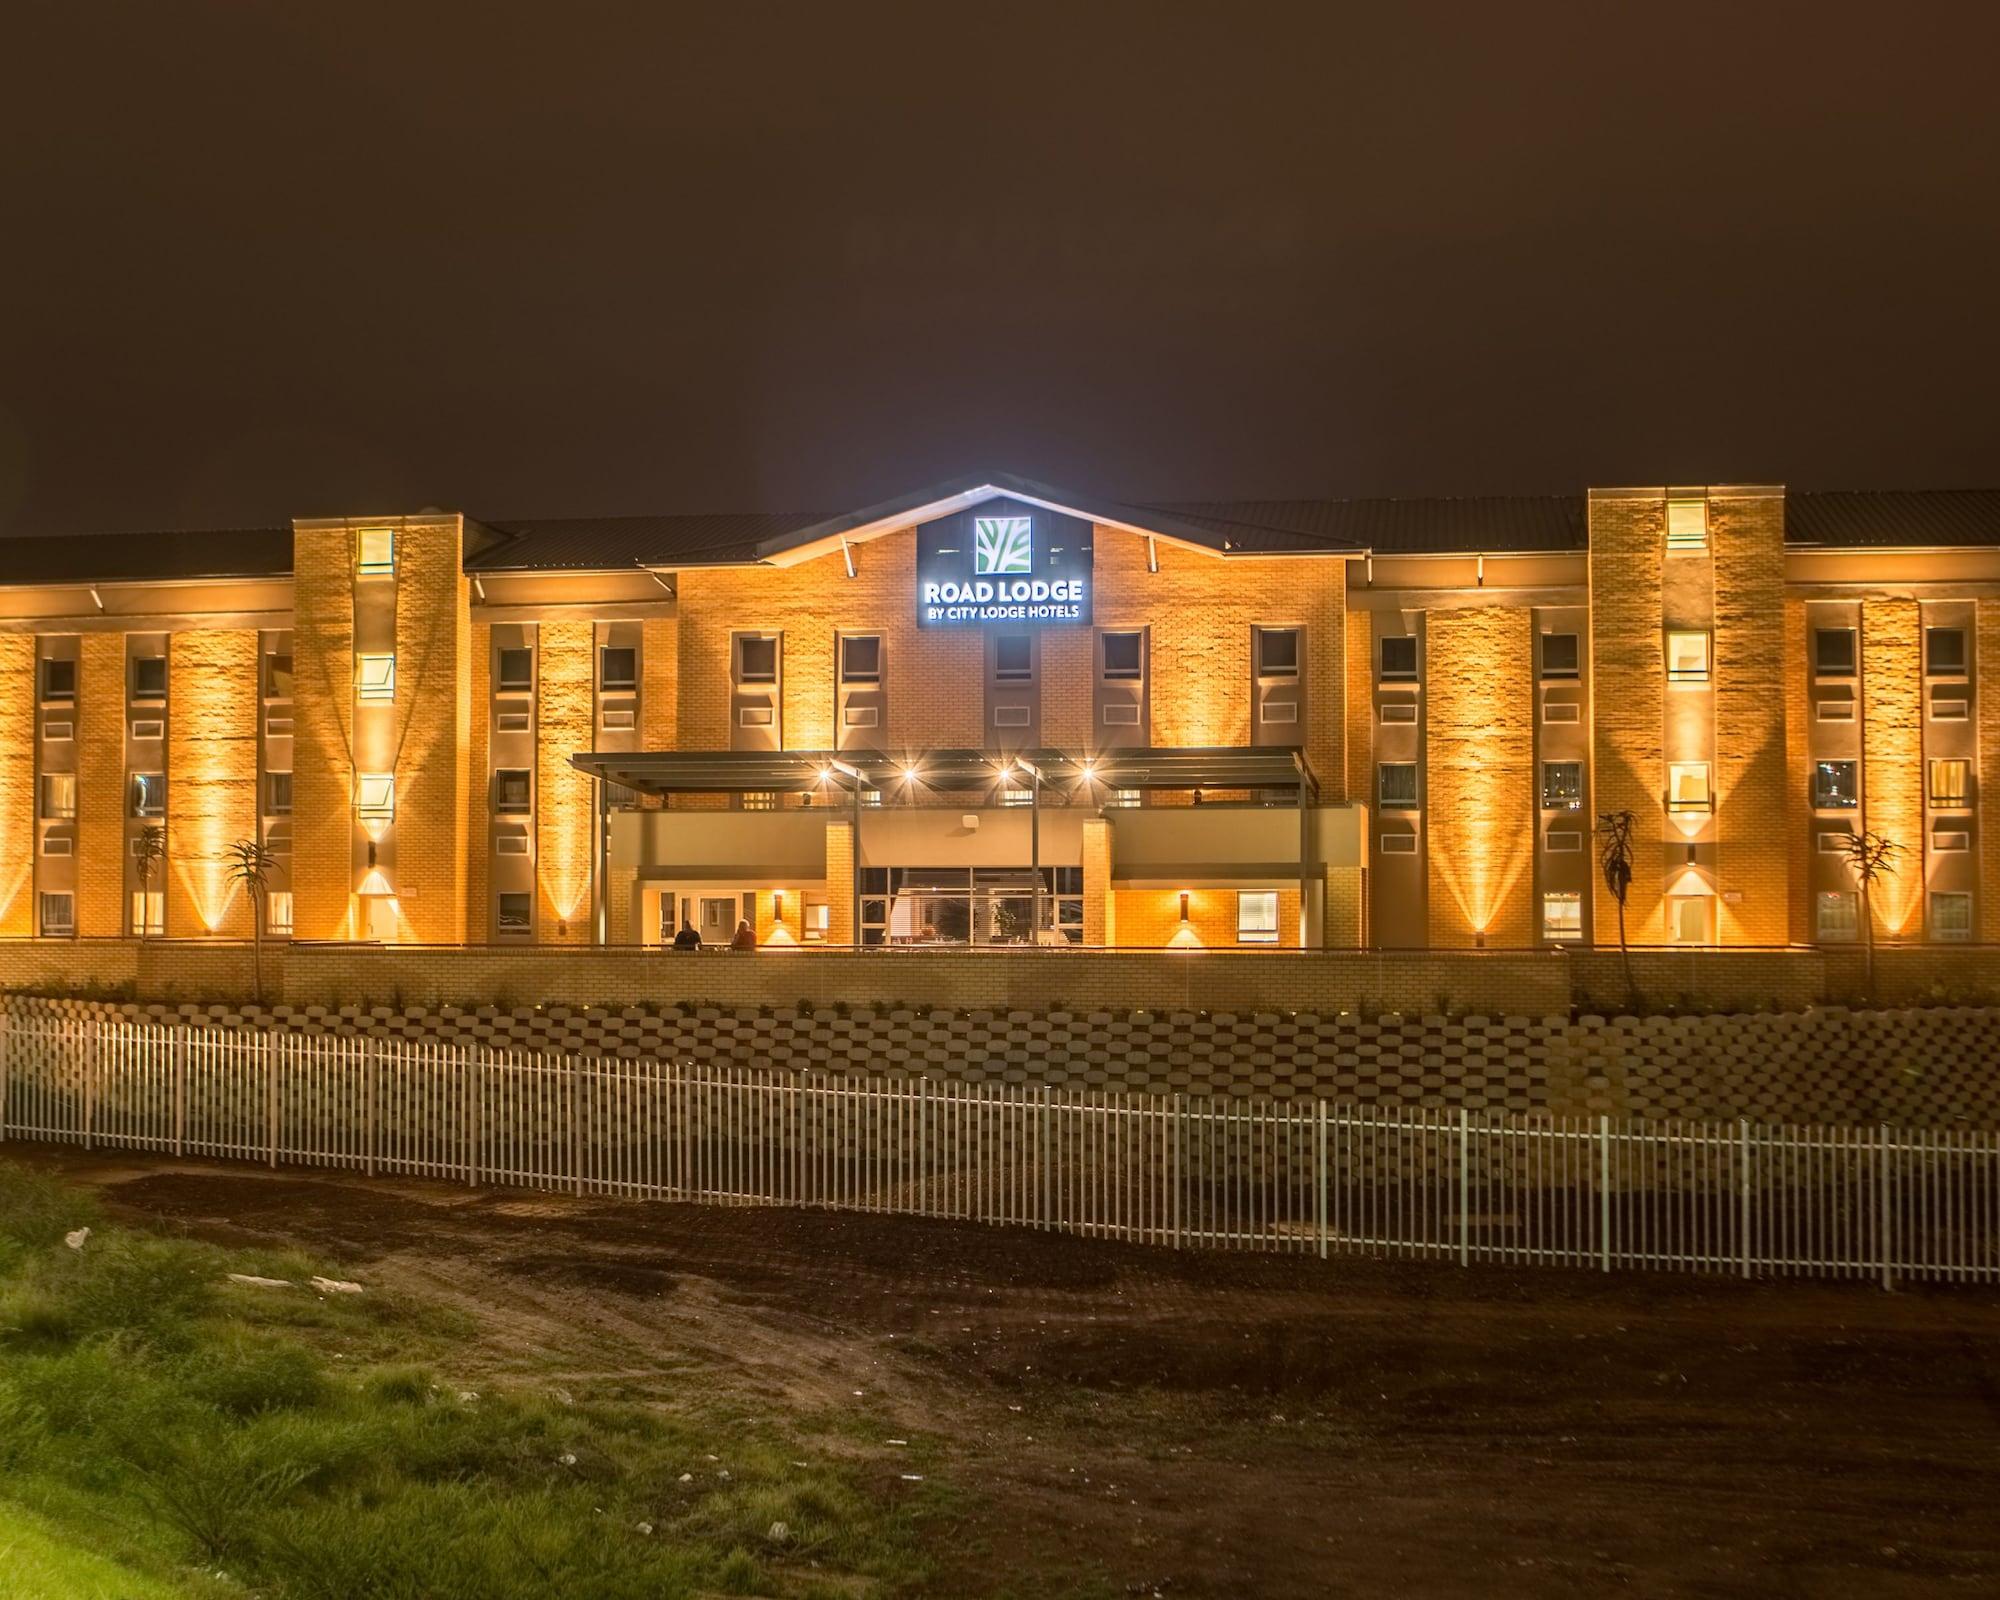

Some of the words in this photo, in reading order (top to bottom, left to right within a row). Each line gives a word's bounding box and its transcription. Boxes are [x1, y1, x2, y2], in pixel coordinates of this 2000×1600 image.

[924, 582, 993, 604] ROAD
[999, 580, 1083, 602] LODGE
[928, 607, 944, 619] BY
[948, 607, 977, 619] CITY
[981, 606, 1025, 619] LODGE
[1029, 605, 1079, 618] HOTELS
